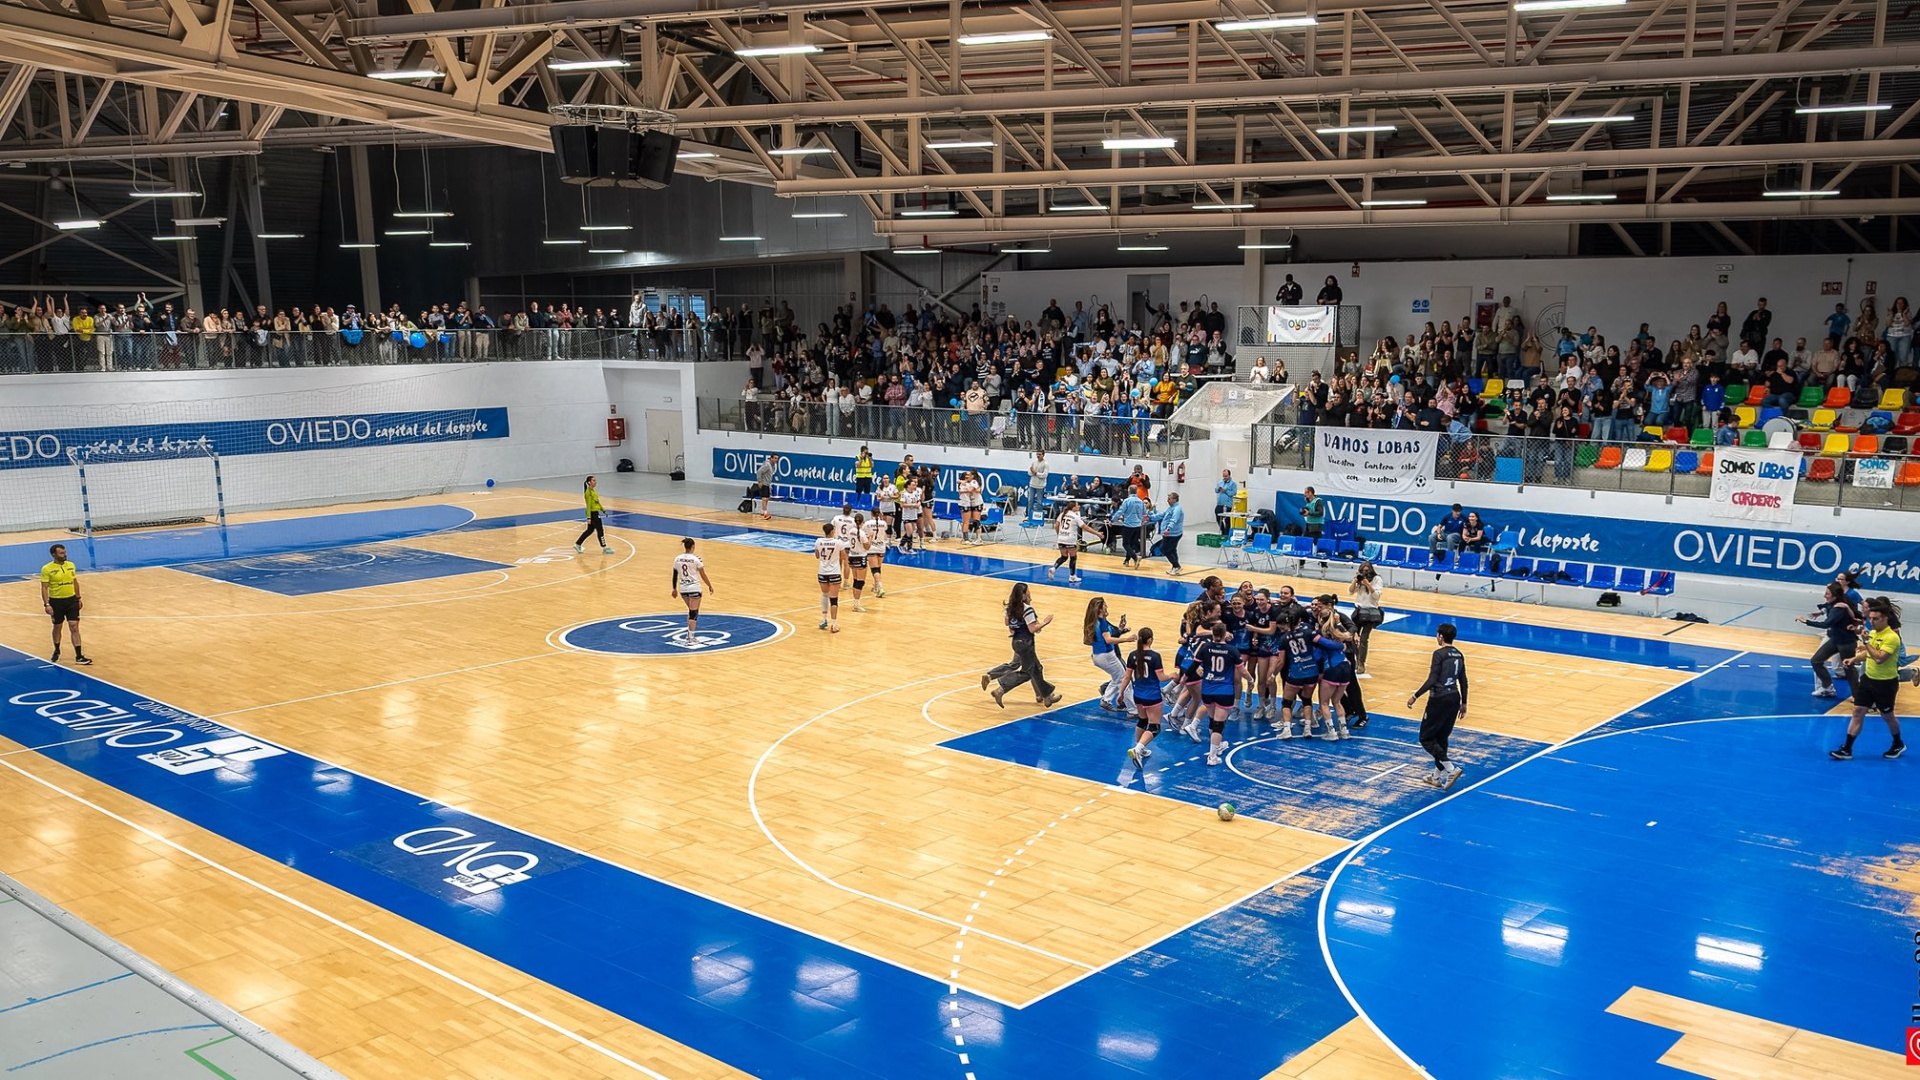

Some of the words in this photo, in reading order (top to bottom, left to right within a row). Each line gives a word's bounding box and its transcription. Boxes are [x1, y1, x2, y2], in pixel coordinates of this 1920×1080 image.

[266, 418, 371, 446] OVIEDO
[375, 423, 420, 441] capital
[422, 422, 443, 436] del
[445, 419, 488, 438] deporte
[1324, 433, 1369, 454] VAMOS
[1377, 440, 1420, 455] LOBAS
[1328, 455, 1355, 467] Vuestra
[1720, 459, 1755, 475] SOMOS
[1758, 462, 1795, 480] LOBAS
[1858, 458, 1890, 471] SOMOS
[794, 465, 827, 482] capital
[828, 468, 845, 484] del
[846, 469, 882, 486] dete
[841, 524, 847, 535] 6
[1323, 500, 1426, 536] VIEDO
[1530, 527, 1600, 553] deporte
[820, 547, 835, 560] 47
[850, 537, 856, 549] 9
[1673, 529, 1842, 574] OVIEDO
[681, 564, 689, 577] 8
[1211, 655, 1225, 672] 10
[9, 689, 183, 748] OVIEDO
[393, 826, 540, 880] OVD
